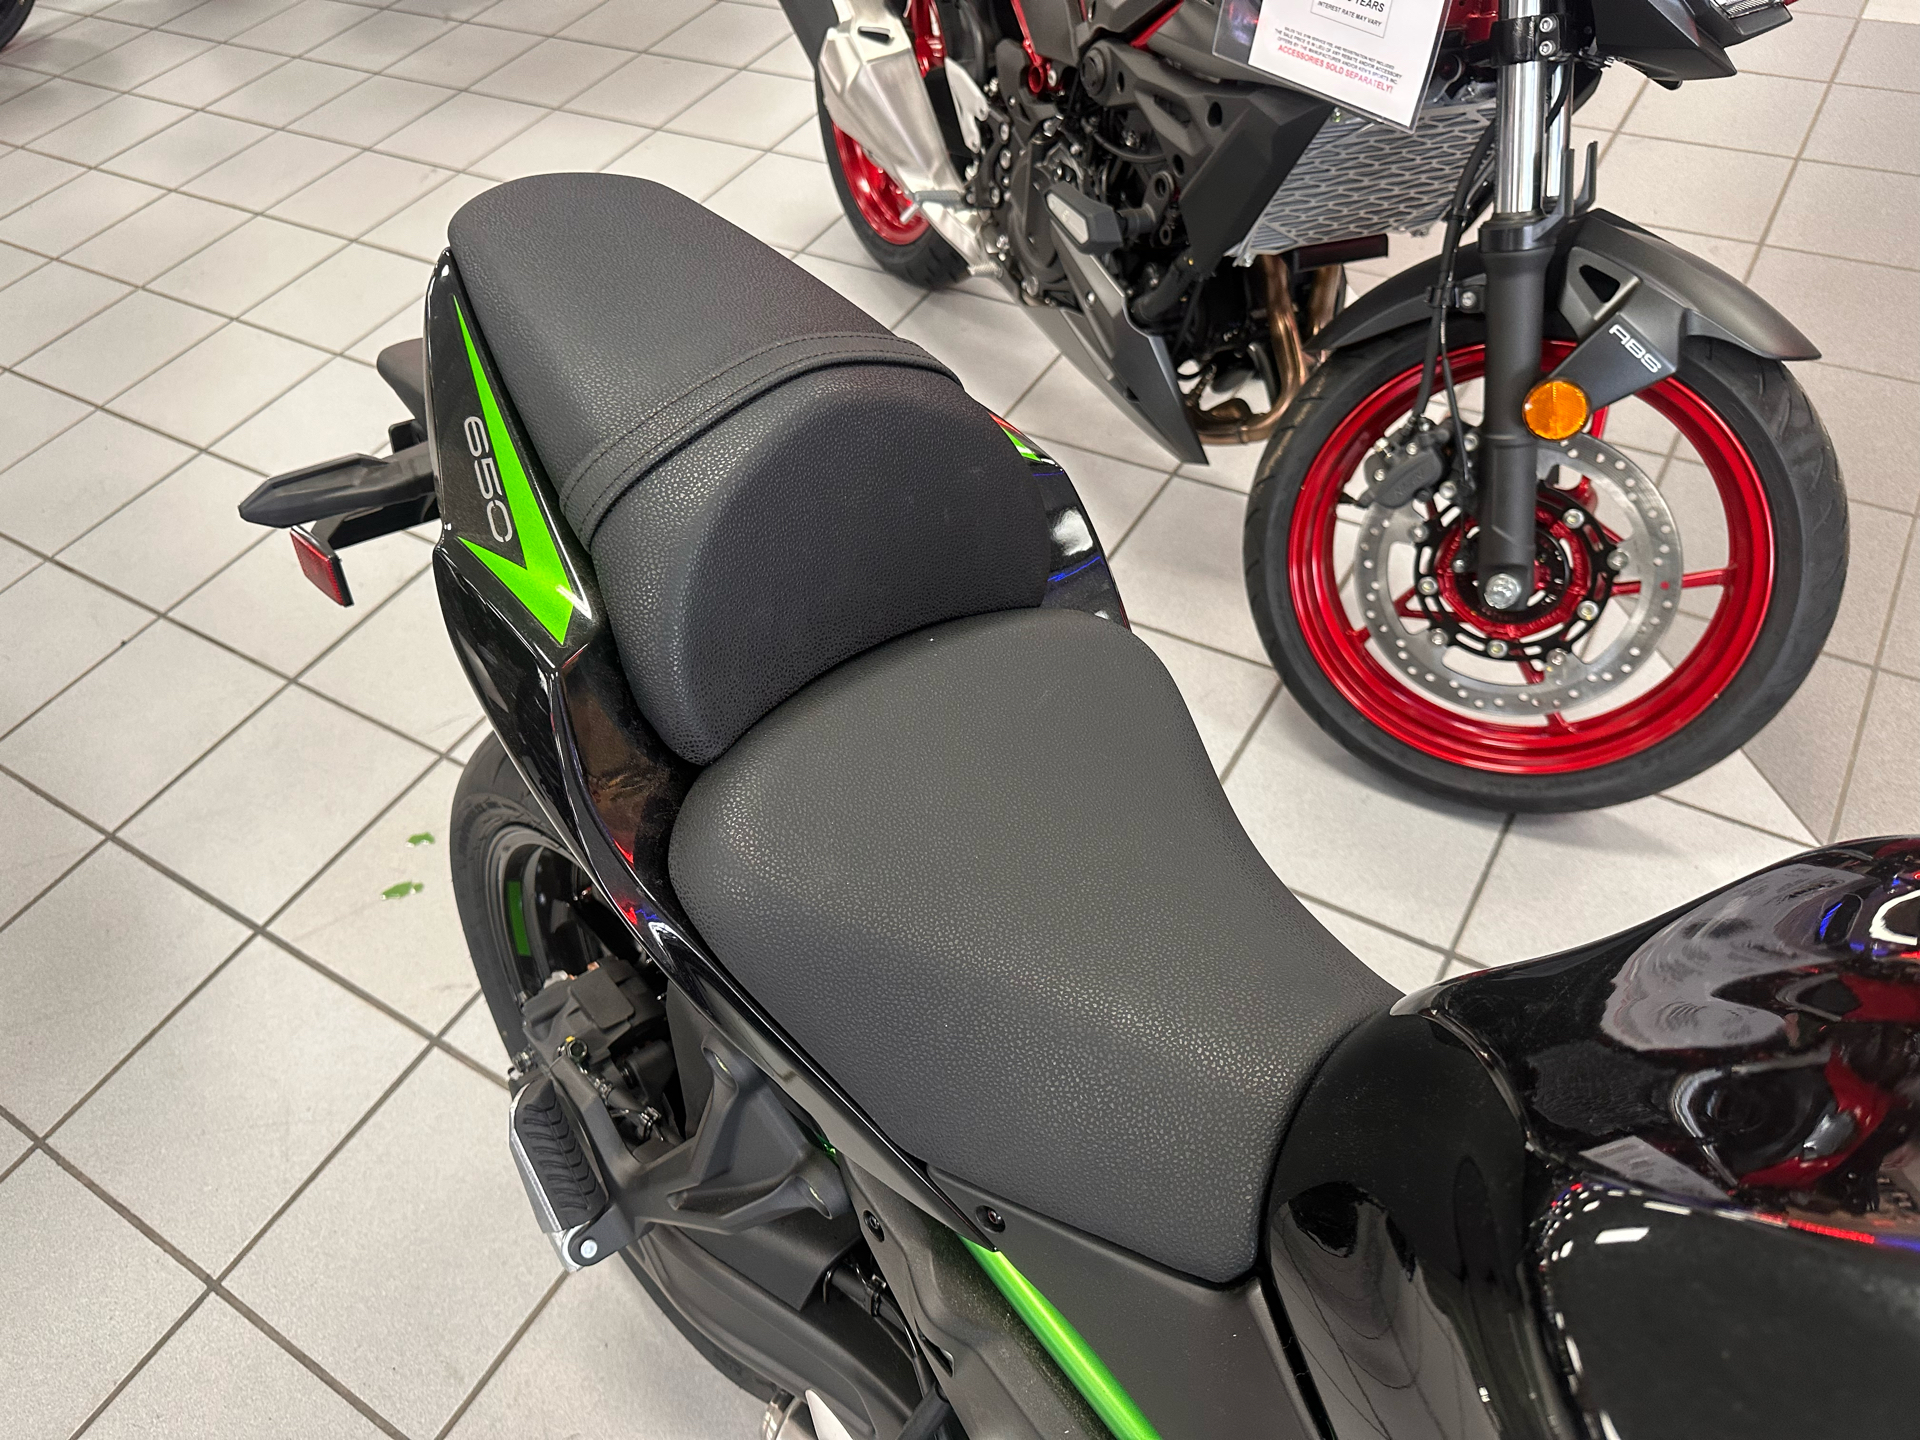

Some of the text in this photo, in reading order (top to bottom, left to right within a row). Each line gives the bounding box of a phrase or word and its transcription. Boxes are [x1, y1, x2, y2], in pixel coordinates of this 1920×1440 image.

[1317, 1, 1382, 27] INTEREST RATE MAY VARY
[1278, 44, 1394, 94] ACCESSORIES SOLD SEPARATELY!
[1308, 48, 1341, 63] MANUFACTURER
[1375, 66, 1402, 79] ACCESSORY
[1608, 324, 1662, 374] ABS
[463, 415, 513, 543] 650
